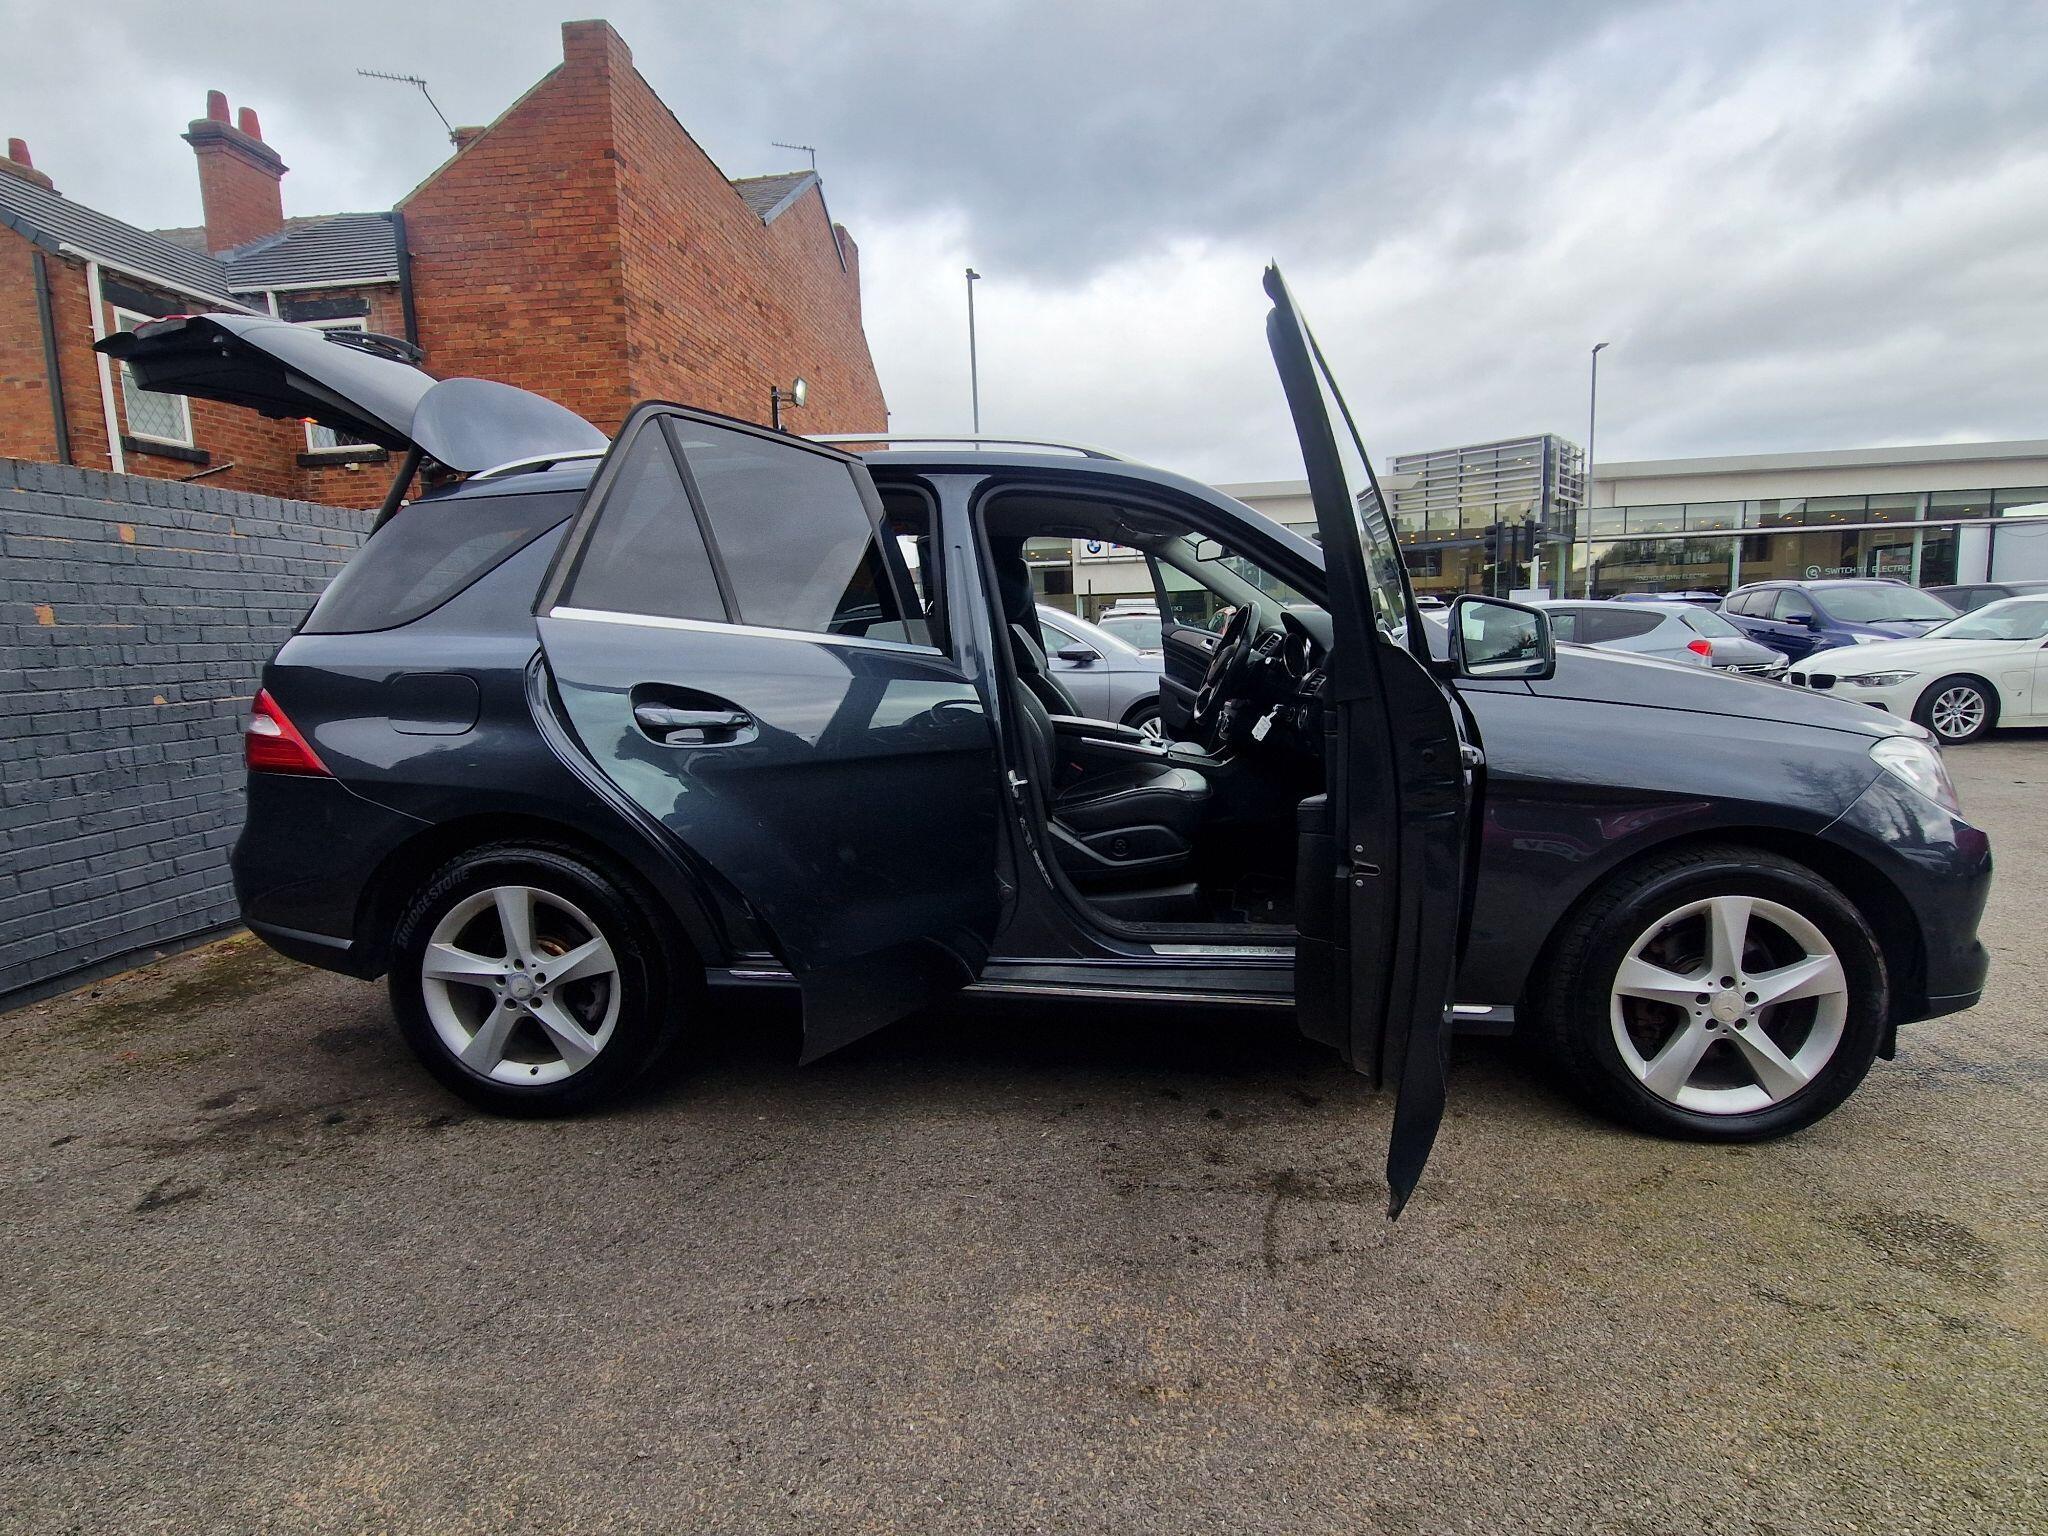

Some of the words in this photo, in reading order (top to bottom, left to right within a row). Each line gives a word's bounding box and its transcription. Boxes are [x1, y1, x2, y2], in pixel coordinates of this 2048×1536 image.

[1825, 567, 1856, 575] SWITCH
[1872, 566, 1911, 575] ELECTRIC
[397, 868, 470, 950] BRIDGESTONE
